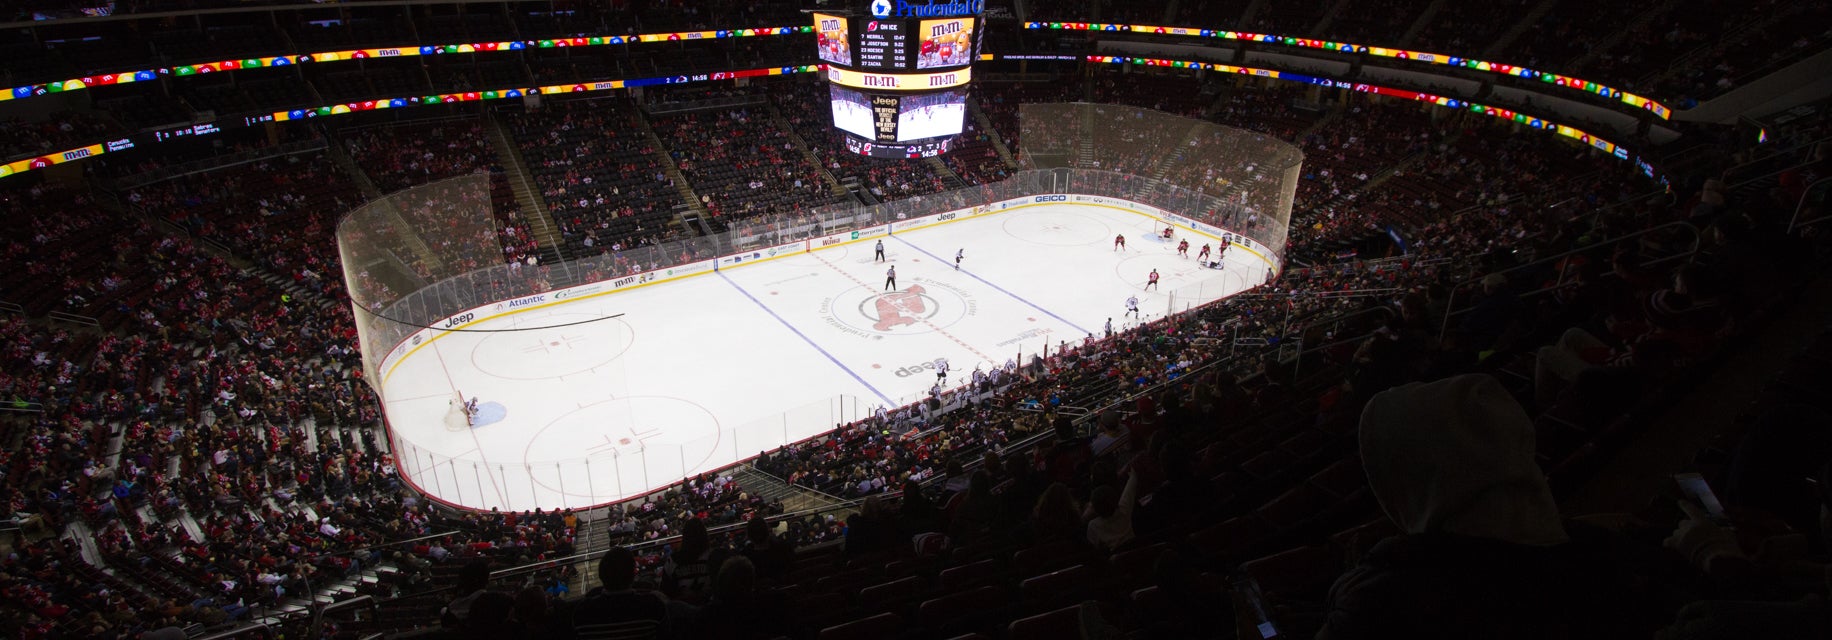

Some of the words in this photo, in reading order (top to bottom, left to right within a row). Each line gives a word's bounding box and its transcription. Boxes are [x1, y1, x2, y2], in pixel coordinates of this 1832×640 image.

[895, 0, 970, 16] Prudential
[873, 96, 898, 106] Jeep
[1035, 195, 1066, 203] GEICO
[937, 213, 956, 222] Jeep
[822, 237, 841, 247] Wawa
[509, 295, 545, 308] Atlantic
[445, 312, 474, 328] Jeep
